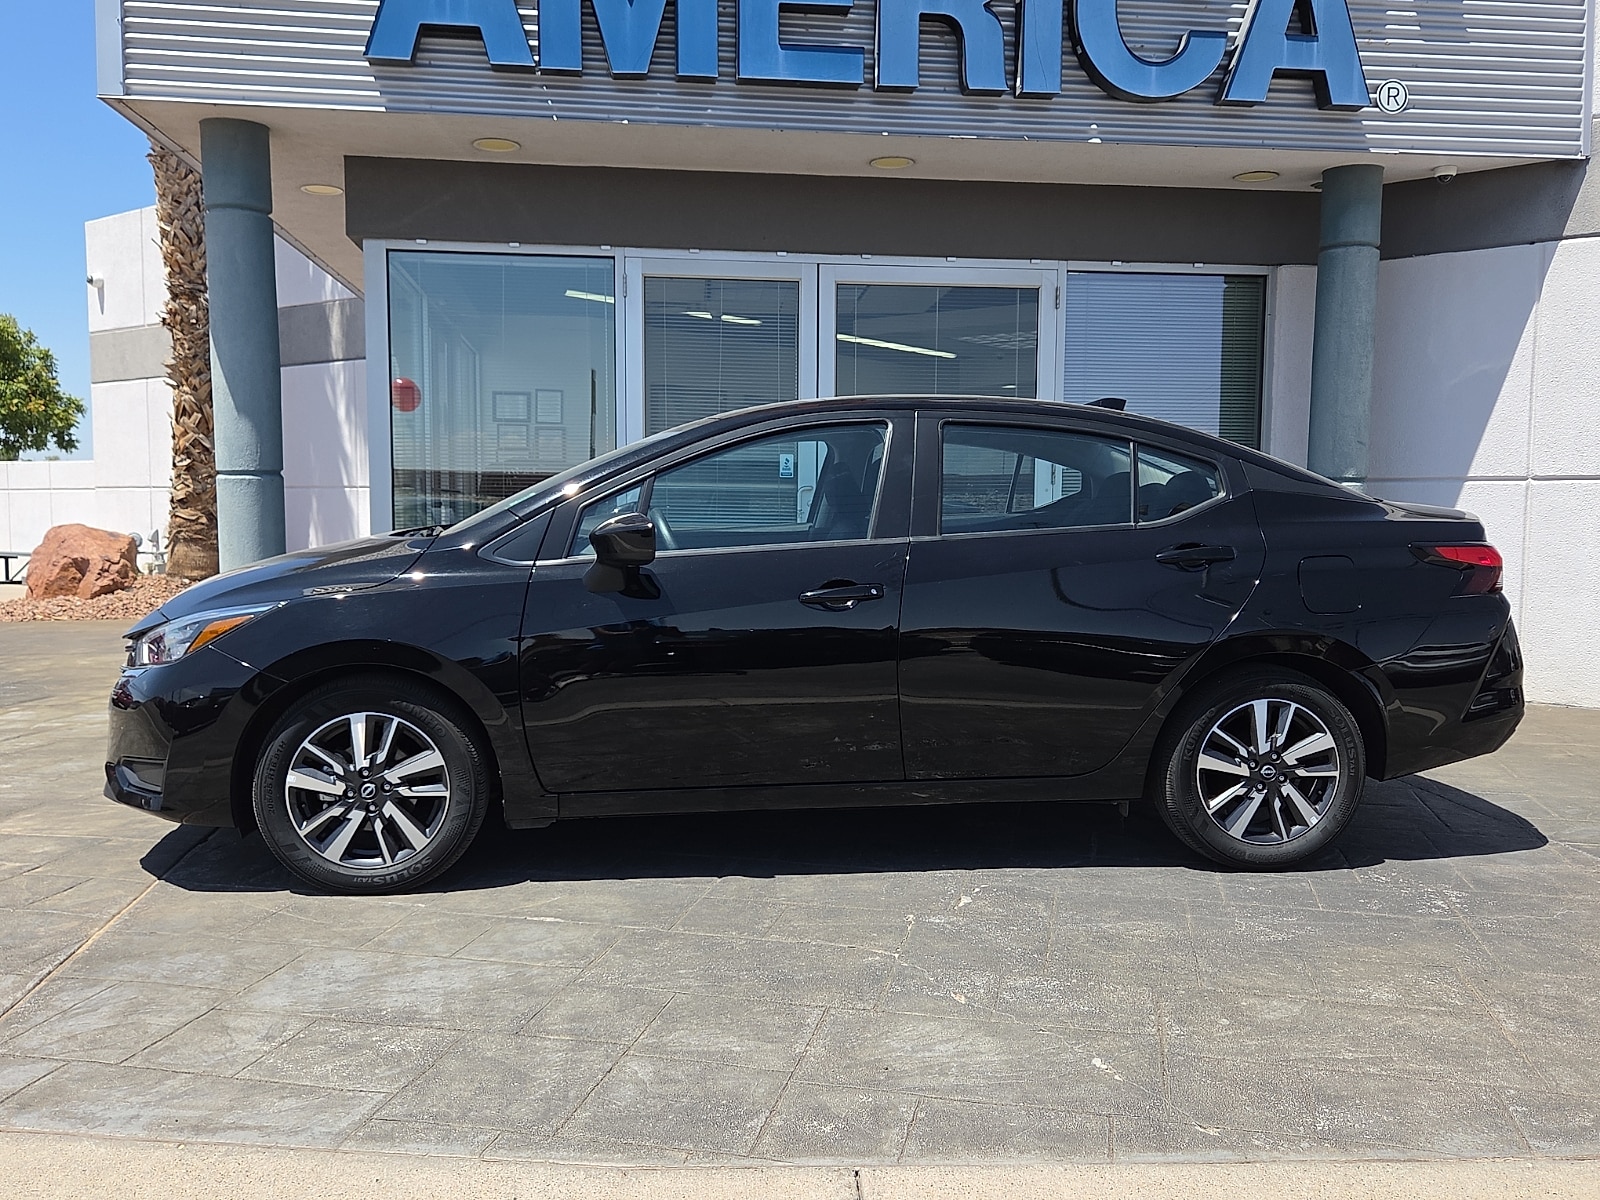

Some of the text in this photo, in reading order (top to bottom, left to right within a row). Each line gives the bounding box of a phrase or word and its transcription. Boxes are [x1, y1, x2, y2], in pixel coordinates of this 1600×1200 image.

[1183, 709, 1216, 761] KUMHO
[1328, 708, 1357, 759] SOLUS
[372, 856, 433, 886] SOLUS
